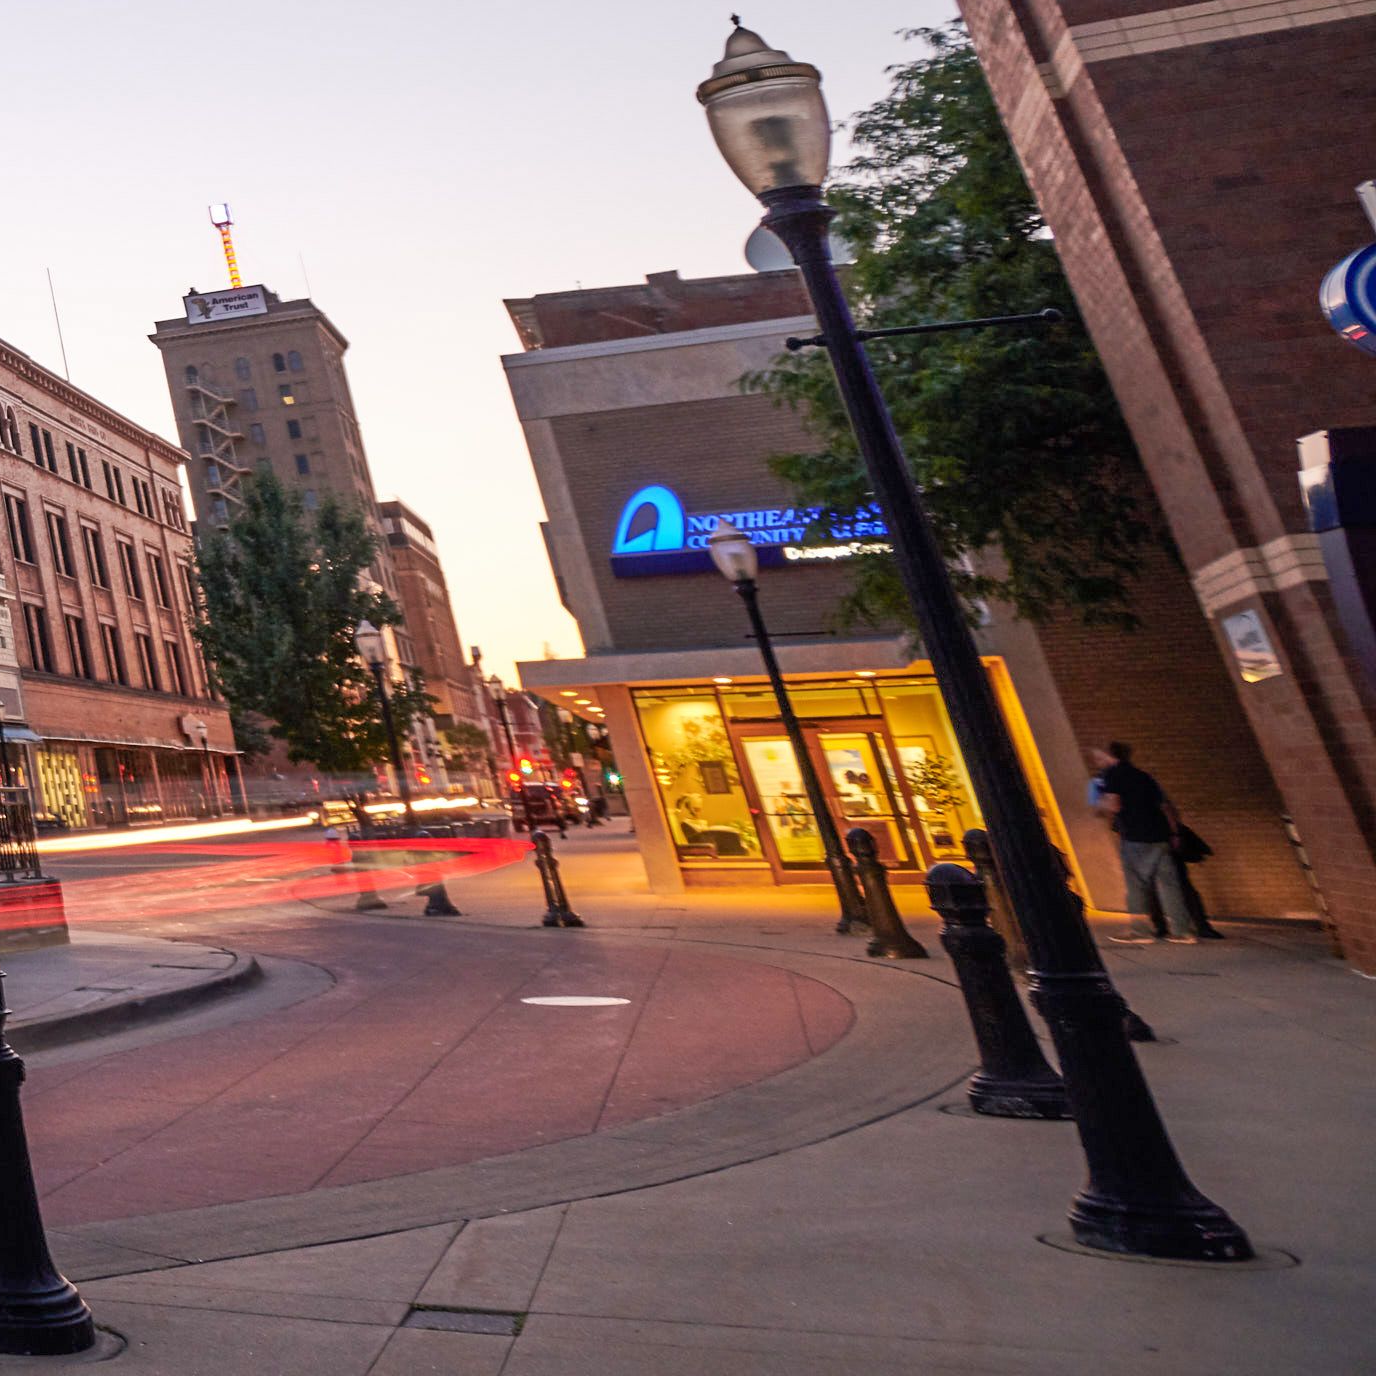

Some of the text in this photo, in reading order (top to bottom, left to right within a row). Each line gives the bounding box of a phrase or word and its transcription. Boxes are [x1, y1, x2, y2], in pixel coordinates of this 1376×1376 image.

[211, 292, 259, 305] American
[223, 301, 249, 311] Trust
[687, 507, 822, 533] NOTHEAT
